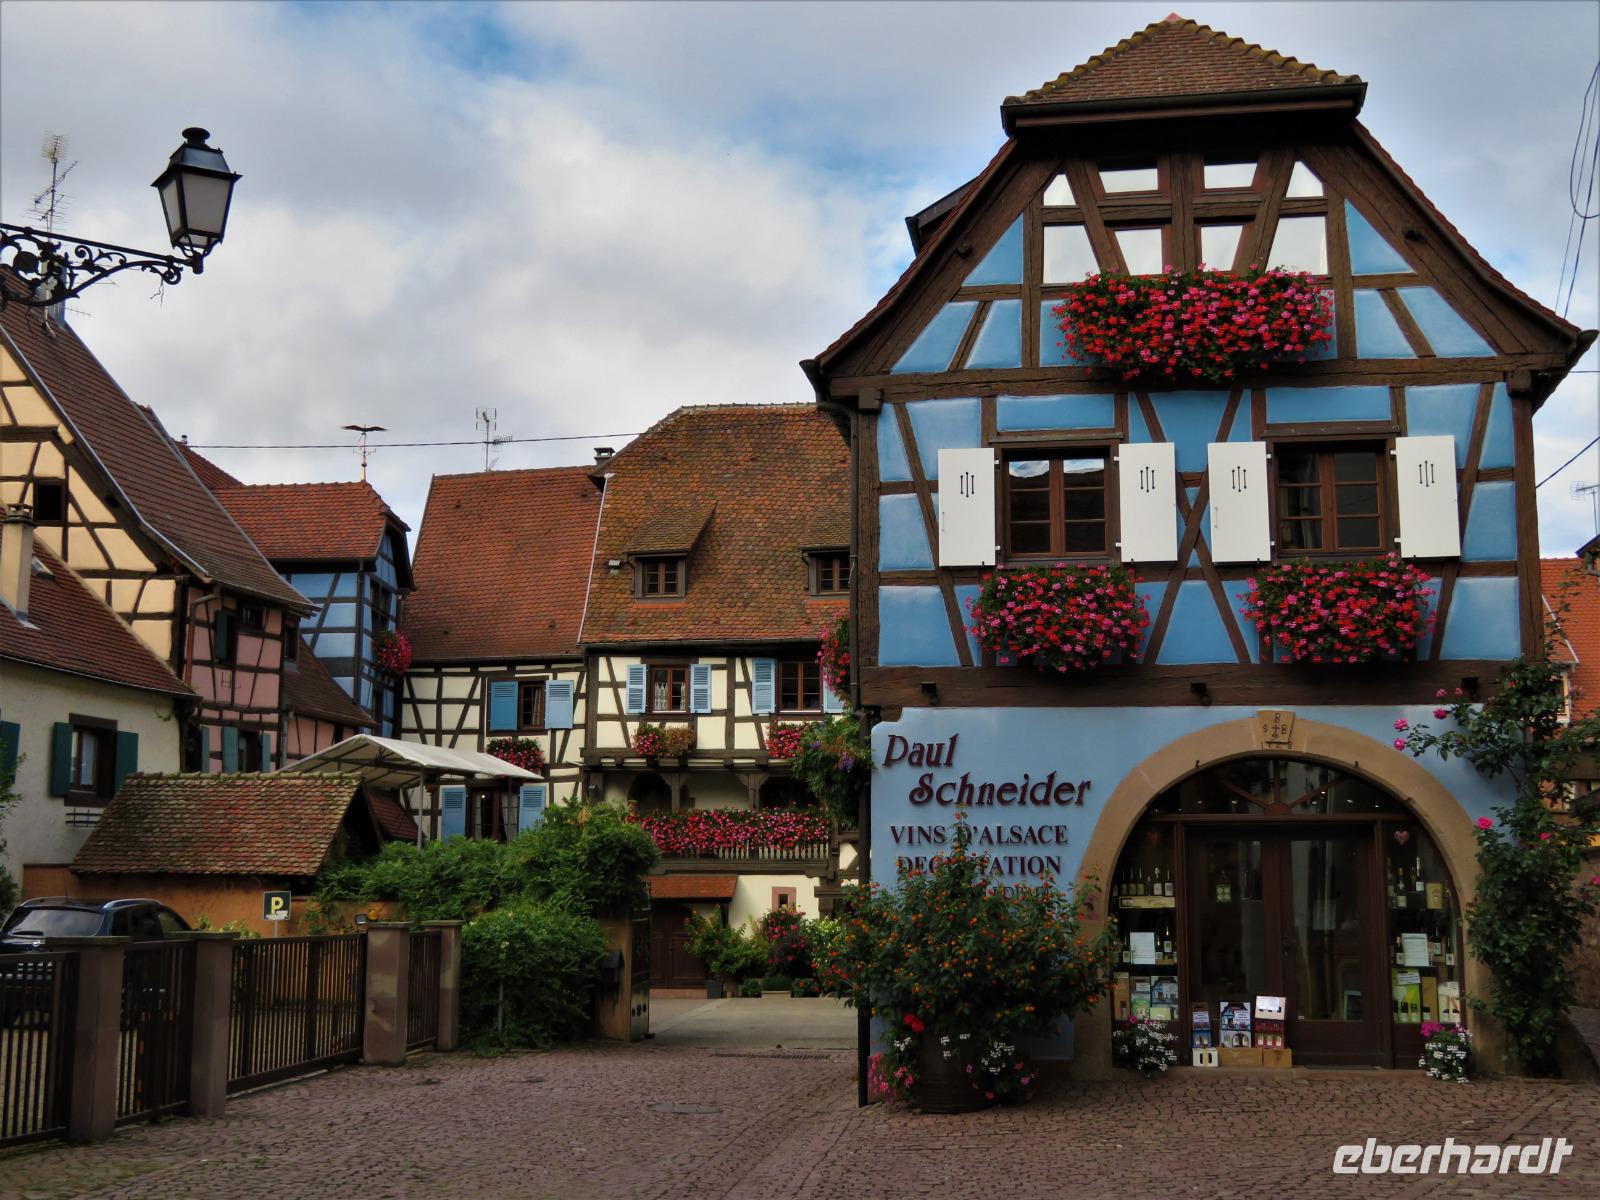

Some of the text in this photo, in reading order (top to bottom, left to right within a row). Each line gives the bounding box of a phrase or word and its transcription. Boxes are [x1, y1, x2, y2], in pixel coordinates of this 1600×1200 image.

[882, 733, 959, 768] Paul
[908, 771, 1091, 806] Schneider
[890, 825, 946, 845] VINS
[898, 856, 1062, 876] DEATION
[271, 896, 284, 915] P
